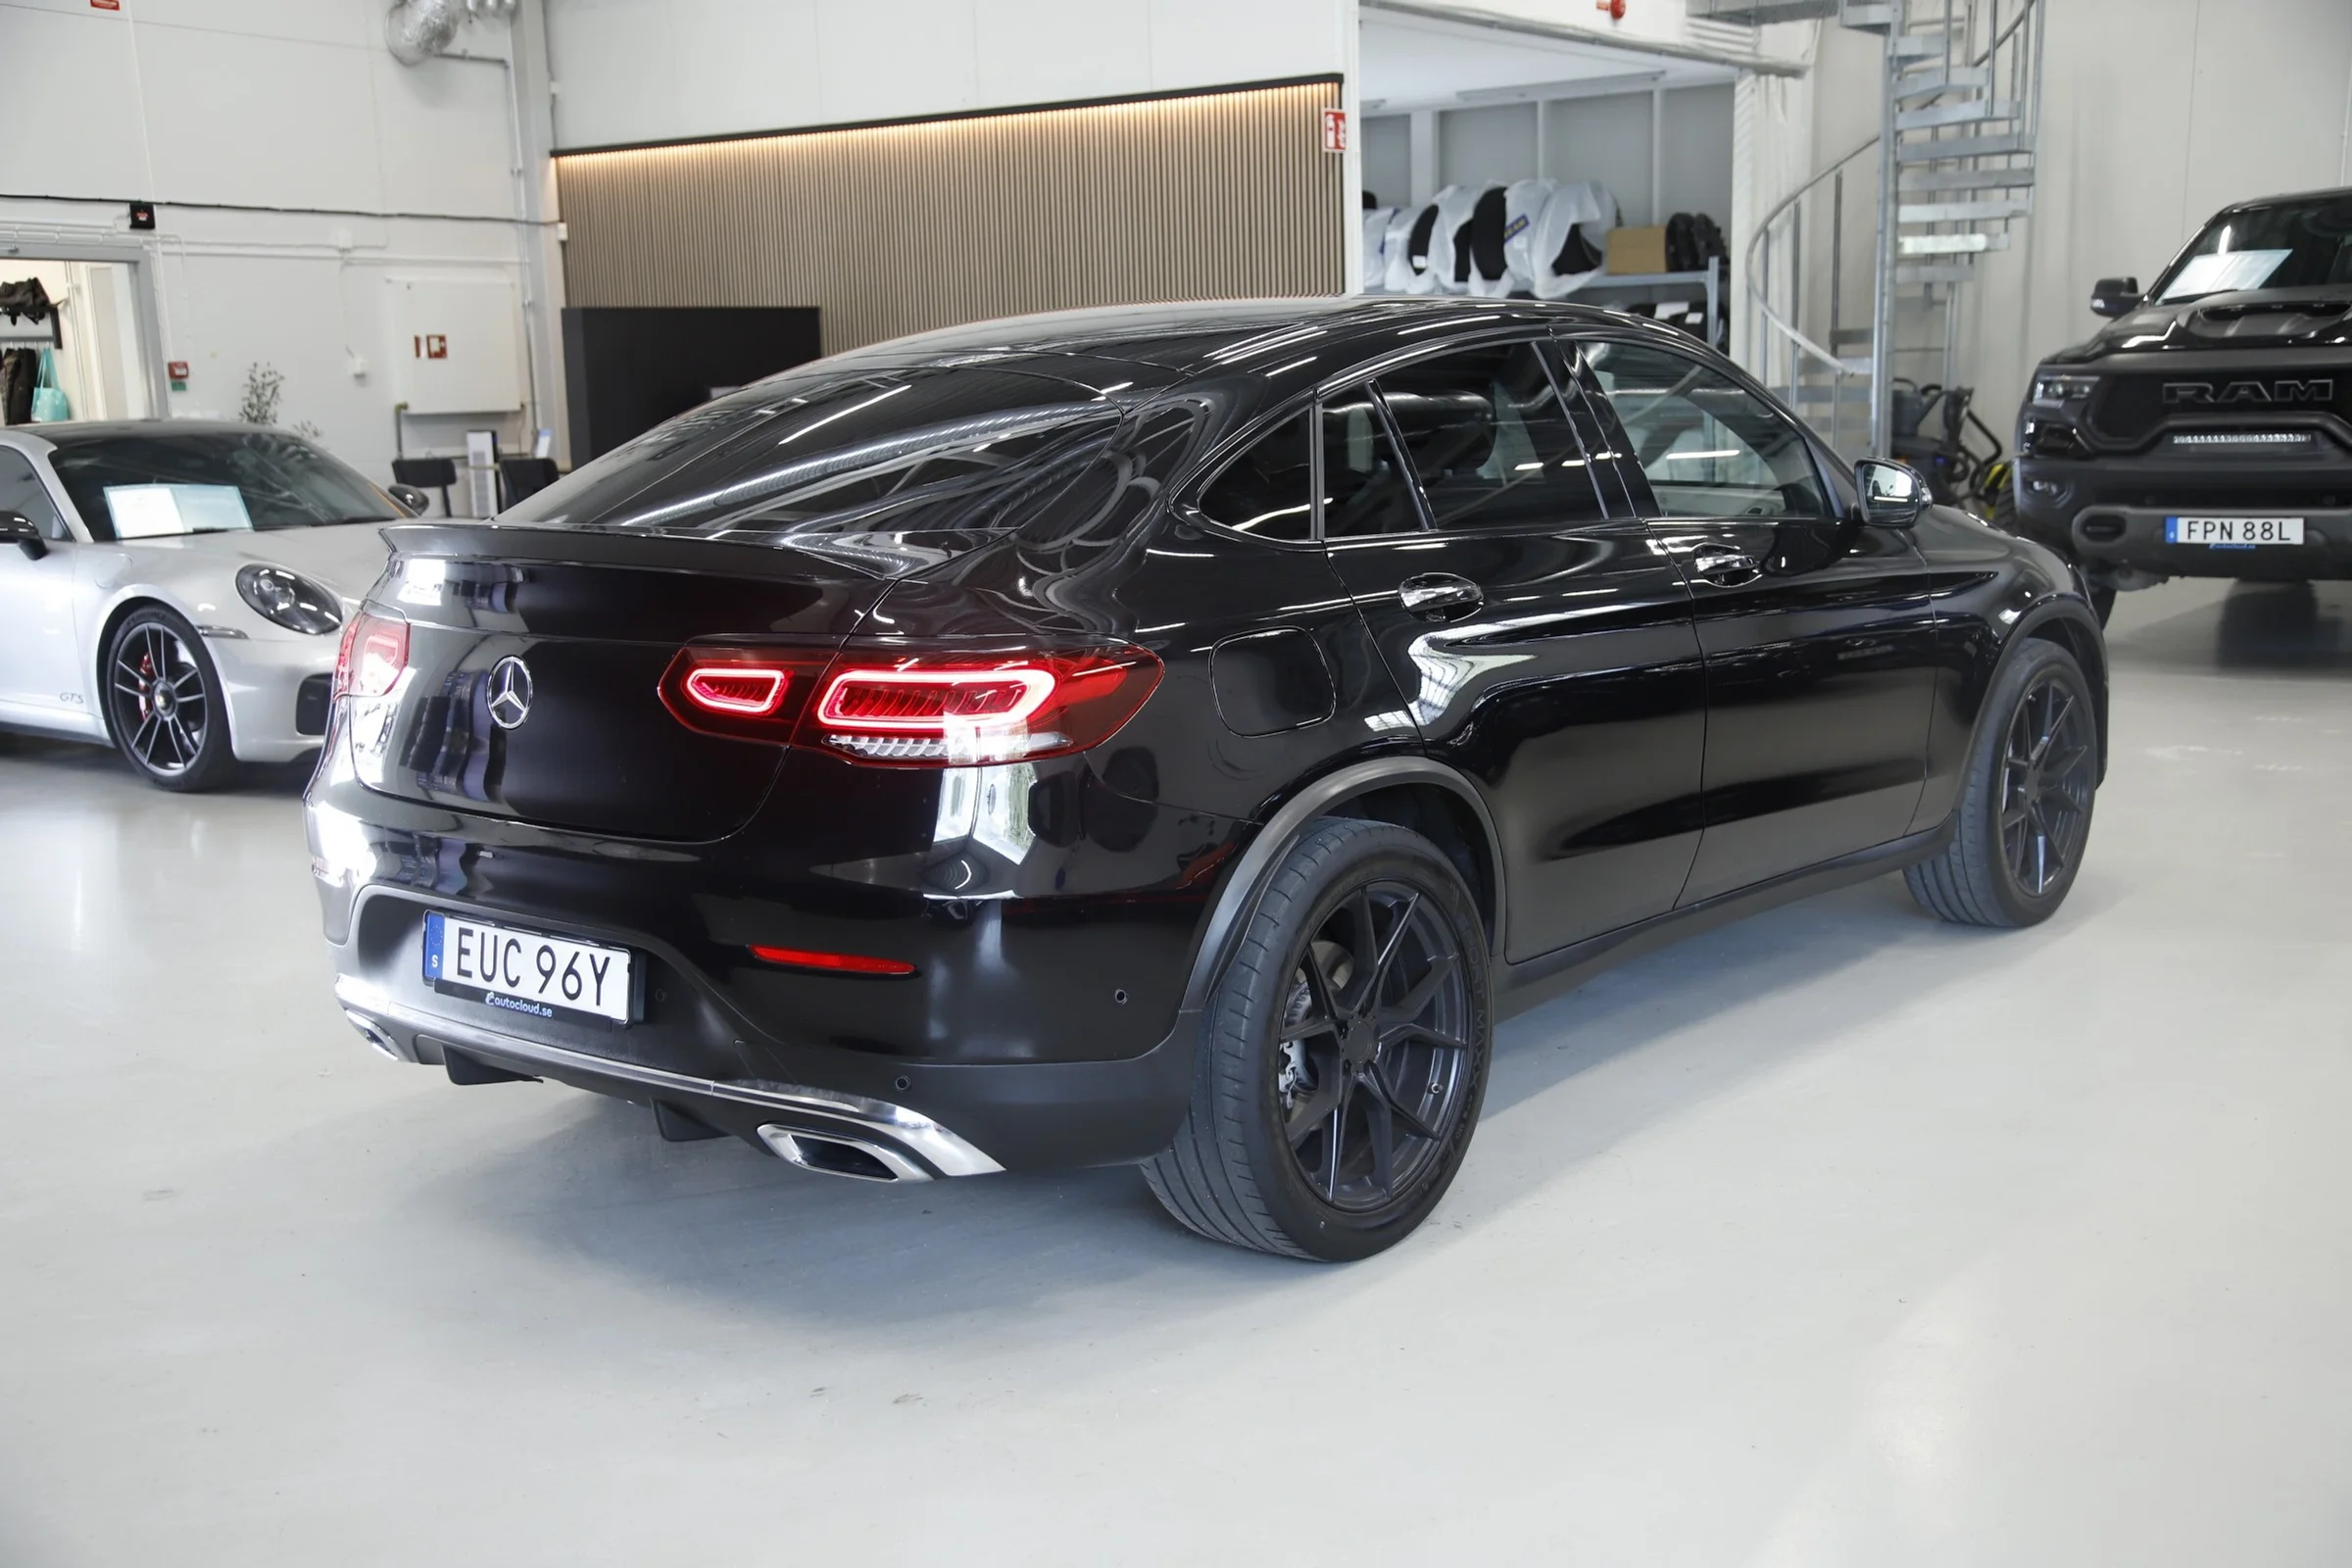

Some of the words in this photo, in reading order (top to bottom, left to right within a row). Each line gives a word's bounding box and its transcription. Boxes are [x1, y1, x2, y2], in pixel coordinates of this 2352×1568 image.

[2163, 379, 2333, 404] RAM
[2187, 520, 2233, 541] FPN
[2242, 520, 2291, 541] 88L
[59, 692, 84, 705] GTS
[431, 955, 439, 969] S
[457, 926, 522, 989] EUC
[536, 945, 611, 1006] 96Y
[494, 994, 553, 1018] autocloud.se
[1457, 913, 1485, 1000] SPORT
[1471, 1008, 1485, 1089] MAXX
